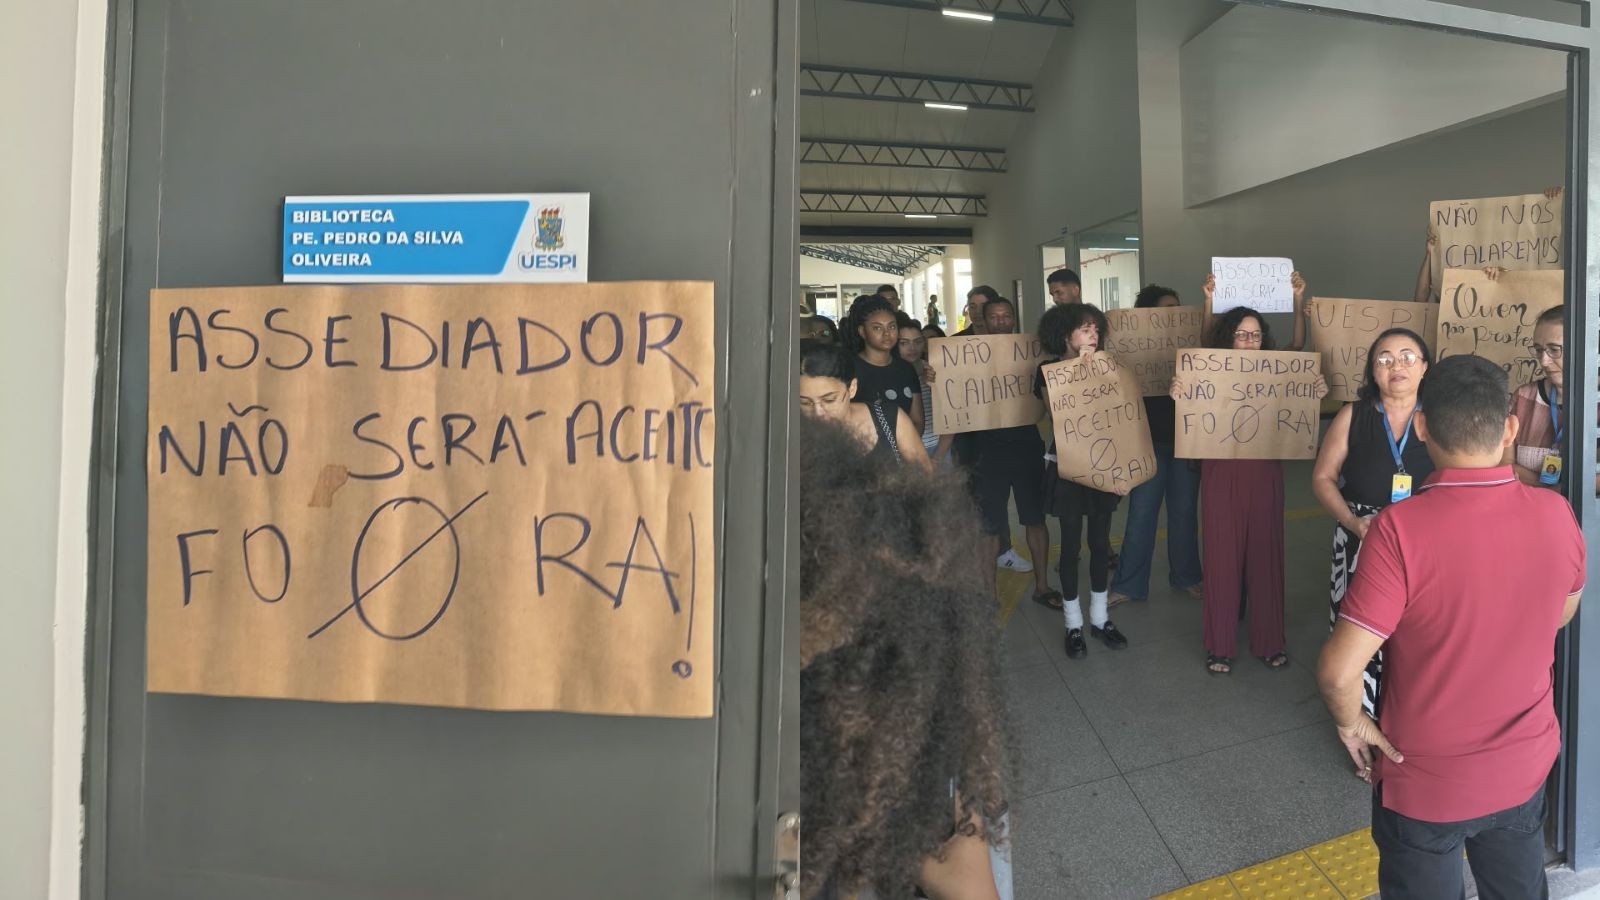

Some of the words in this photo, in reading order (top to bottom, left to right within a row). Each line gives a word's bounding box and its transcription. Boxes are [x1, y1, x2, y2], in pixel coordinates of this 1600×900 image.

[292, 209, 395, 224] BIBLIOTECA
[1436, 202, 1478, 228] NÃO
[1501, 202, 1554, 225] NOS
[292, 232, 318, 246] PE.
[323, 231, 381, 245] PEDRO
[386, 231, 409, 245] DA
[413, 230, 464, 245] SILVA
[291, 253, 373, 267] OLIVEIRA
[521, 254, 578, 270] UESPI
[1445, 236, 1559, 267] CALAREMOS
[168, 305, 700, 387] ASSEDIADOR
[941, 337, 992, 368] NÃO
[1181, 352, 1319, 378] ASSEDIADOR
[1052, 393, 1077, 412] NÃO
[158, 401, 290, 478] NÃO
